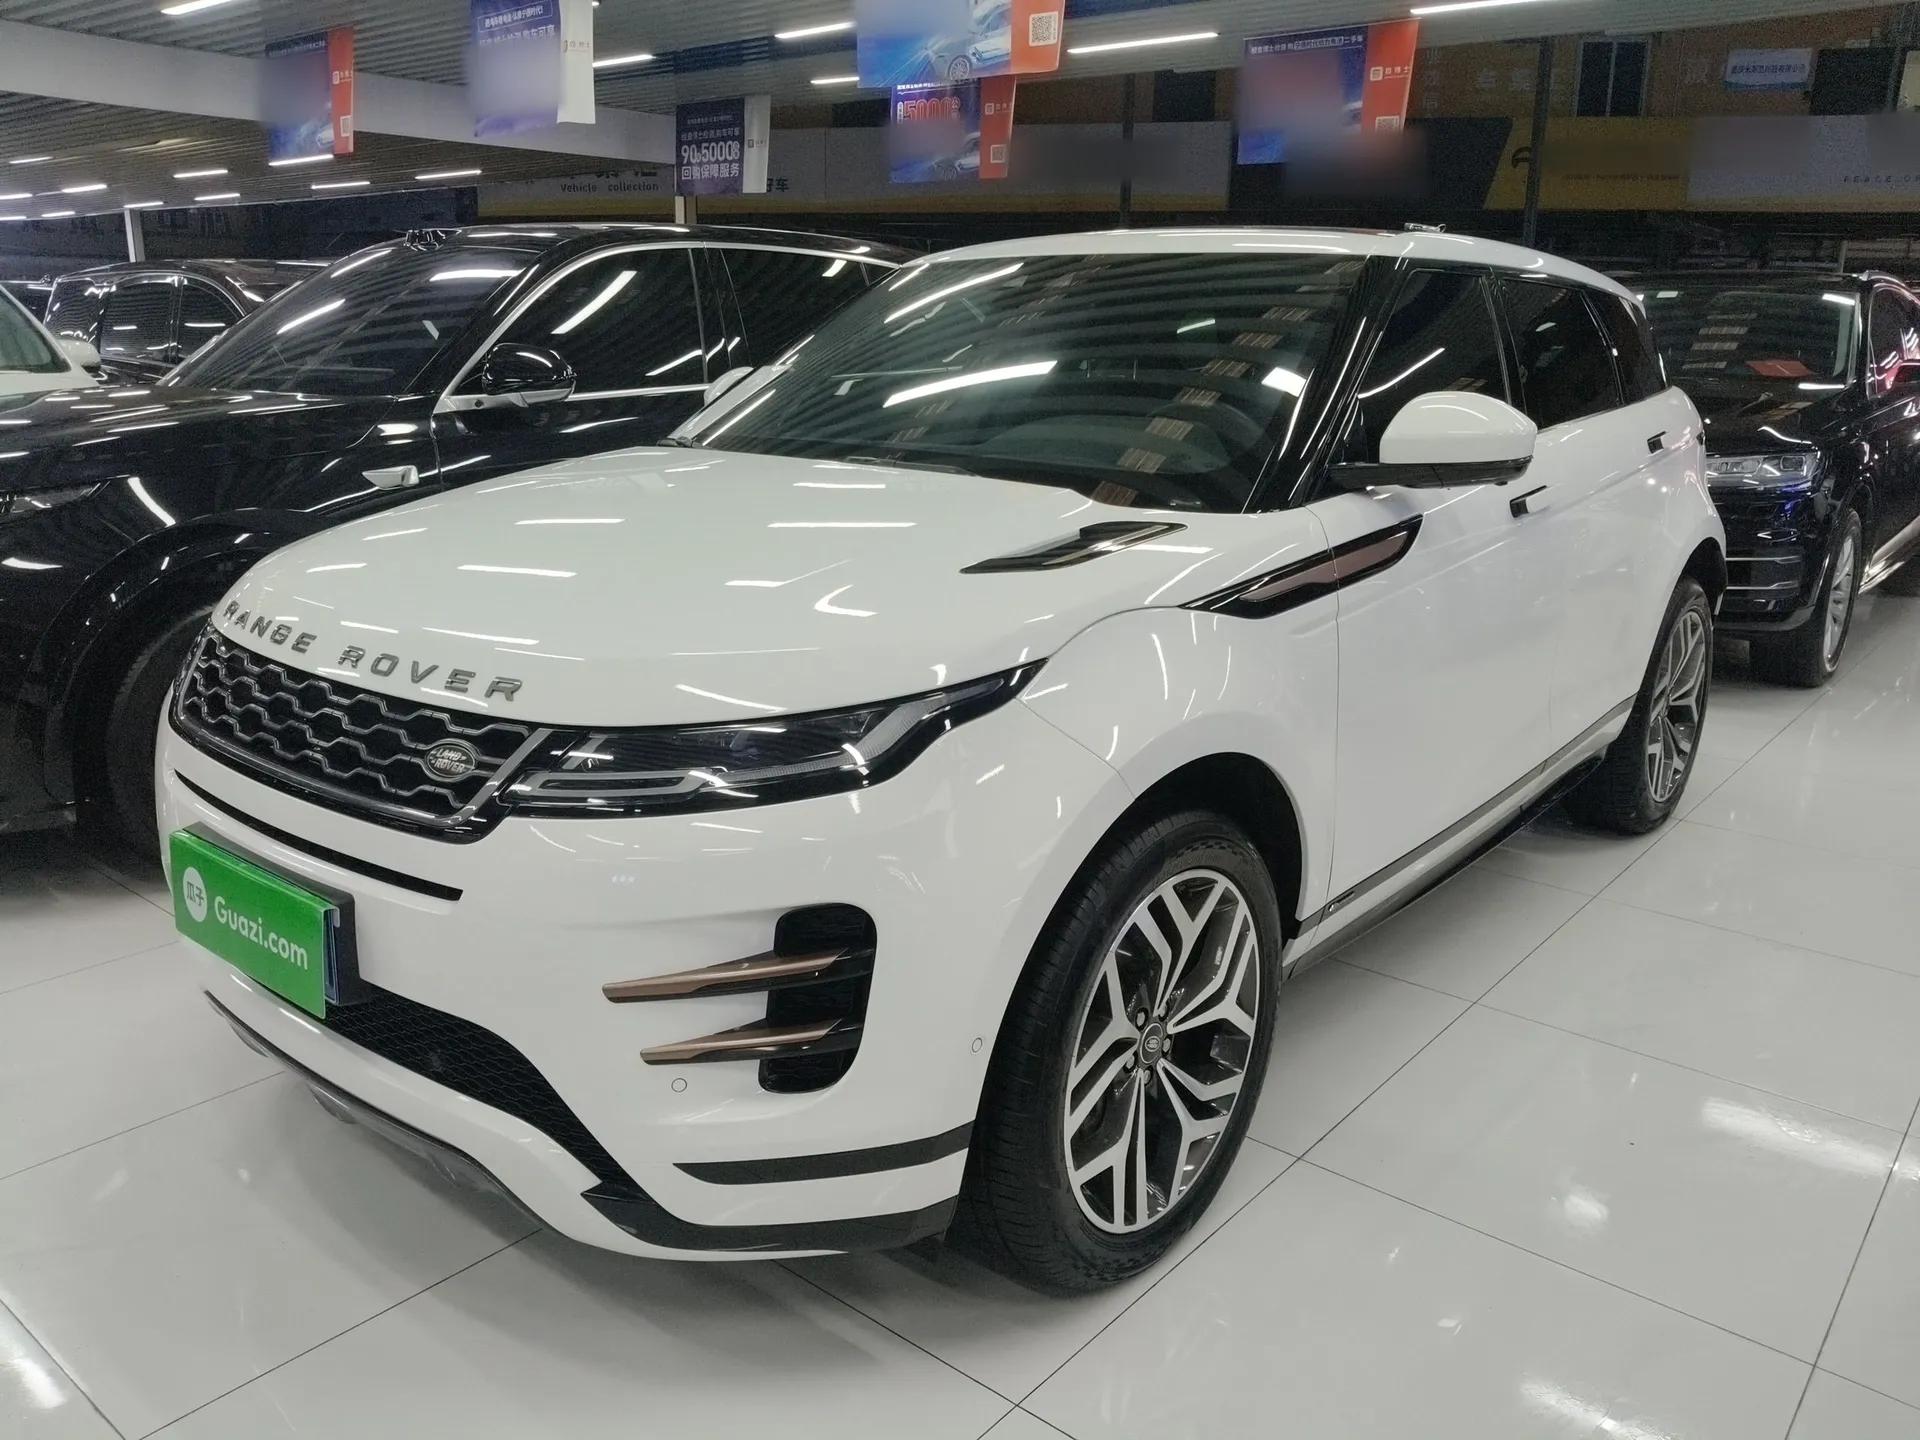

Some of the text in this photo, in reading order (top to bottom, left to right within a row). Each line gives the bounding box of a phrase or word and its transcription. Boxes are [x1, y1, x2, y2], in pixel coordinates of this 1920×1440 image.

[682, 163, 740, 180] 回购保障服务
[560, 181, 659, 192] Vehicle collection
[223, 600, 523, 702] RANGE ROVER
[436, 748, 462, 761] LAND
[434, 758, 465, 773] ROVER
[186, 881, 205, 907] 瓜子
[214, 896, 308, 970] Guazi.com
